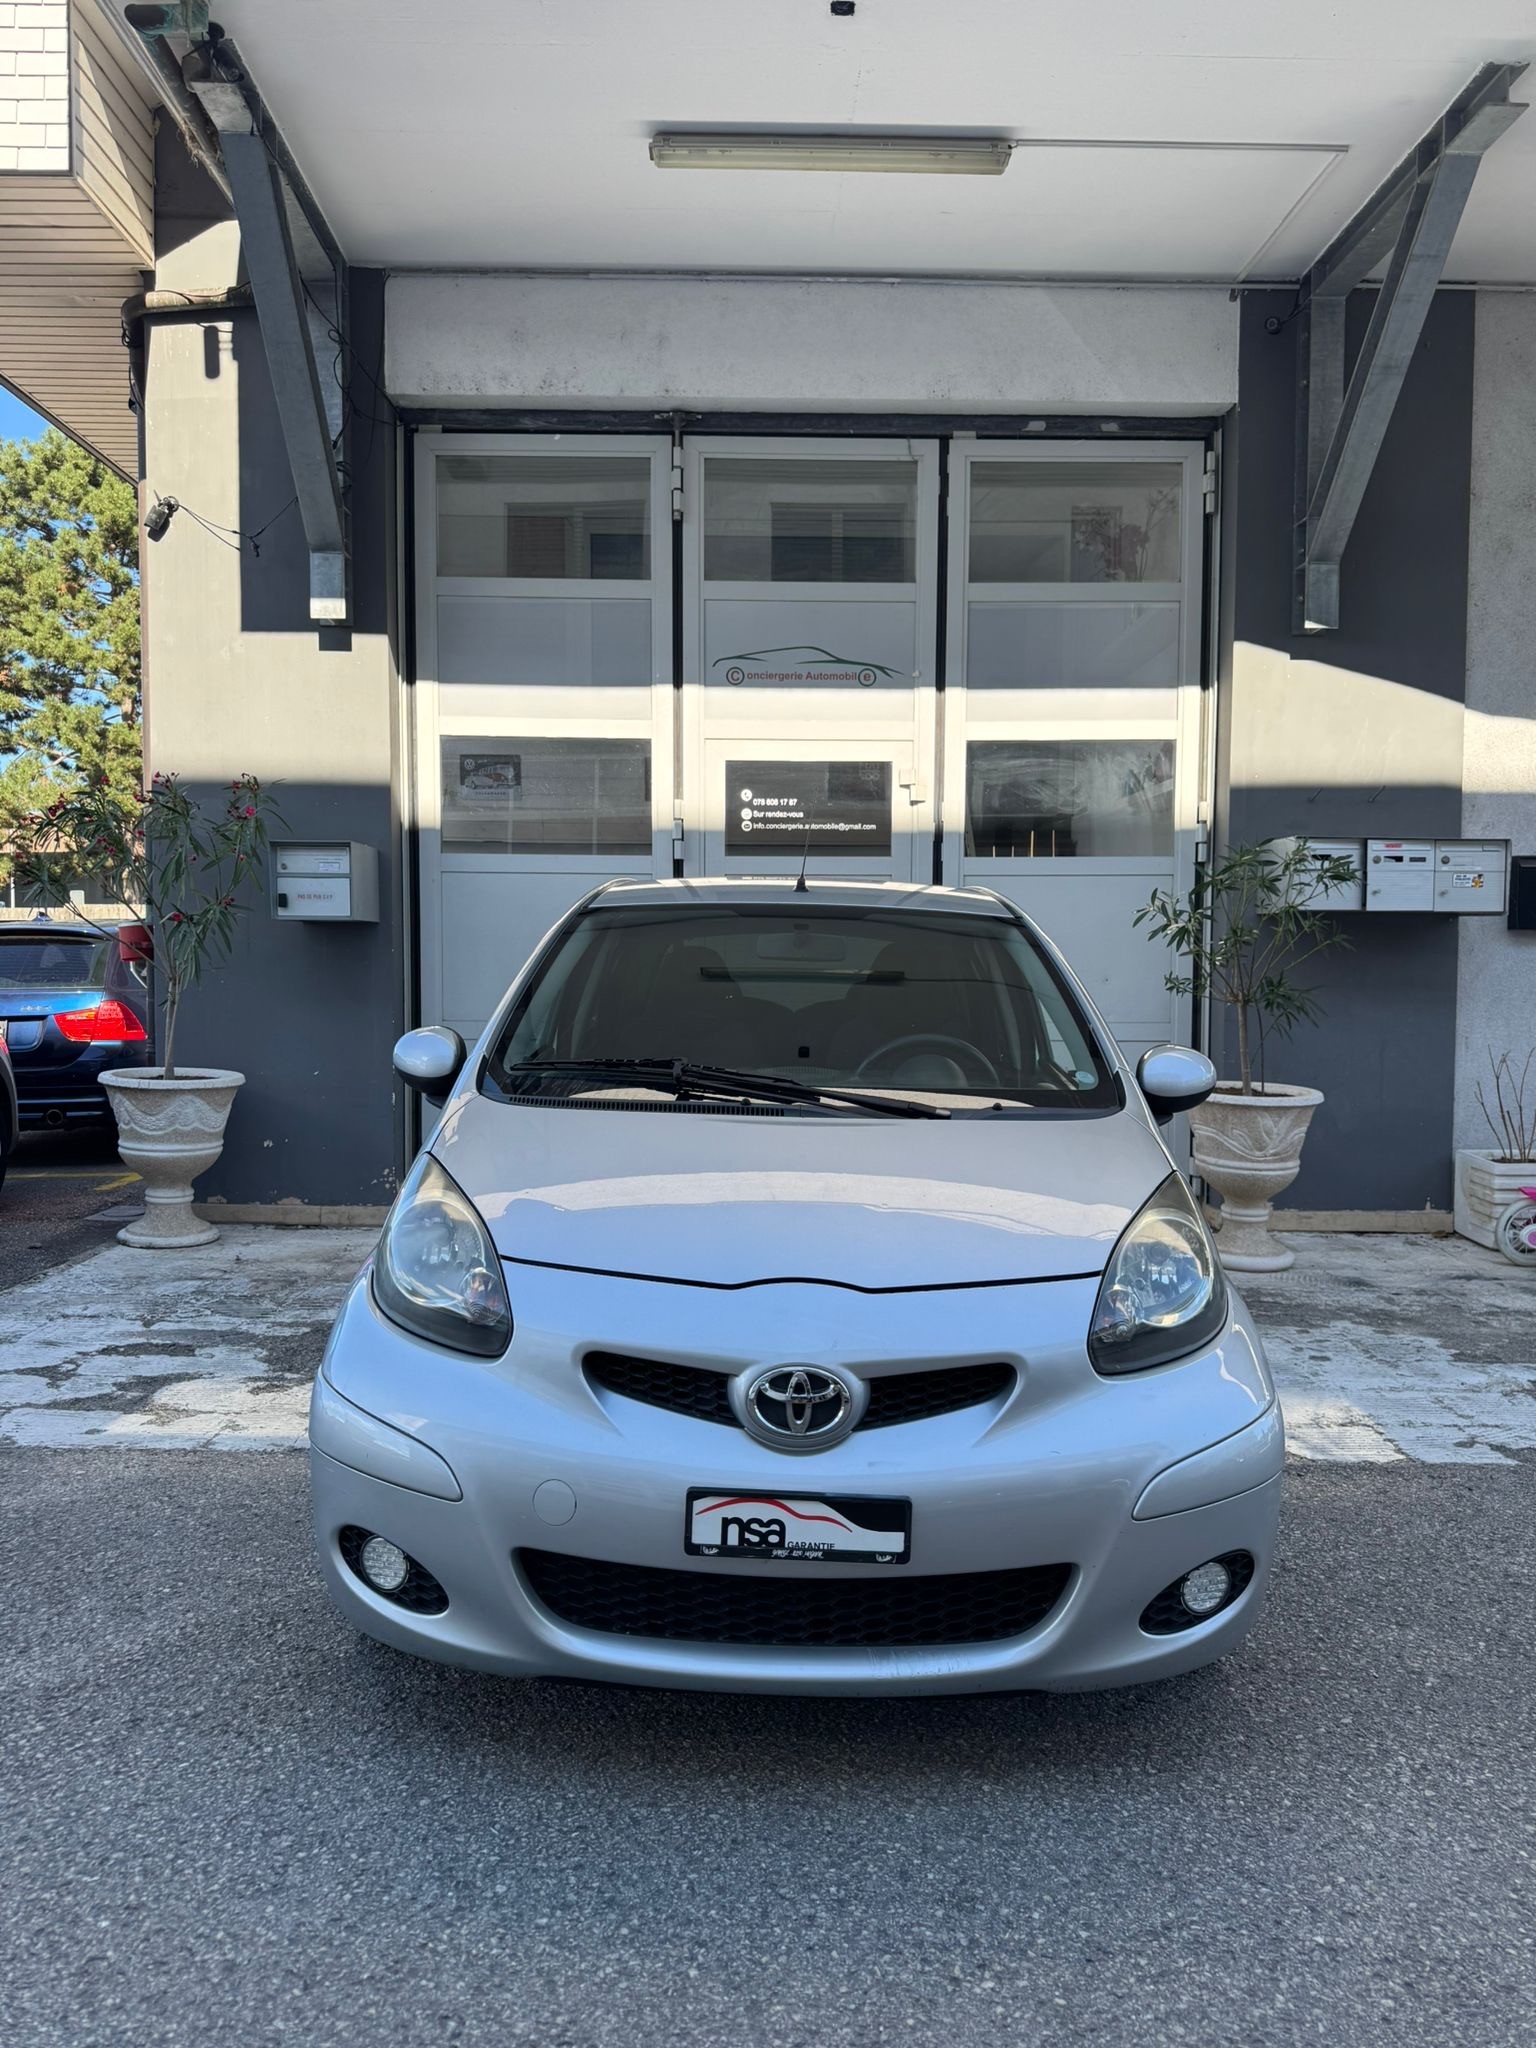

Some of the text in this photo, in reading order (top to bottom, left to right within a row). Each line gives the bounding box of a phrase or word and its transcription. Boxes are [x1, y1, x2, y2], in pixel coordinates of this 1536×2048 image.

[805, 670, 874, 685] Automobile
[780, 798, 789, 807] 17
[753, 810, 804, 818] Sur rendez-vous
[721, 1516, 786, 1548] nsa
[787, 1541, 835, 1550] GARANTIE
